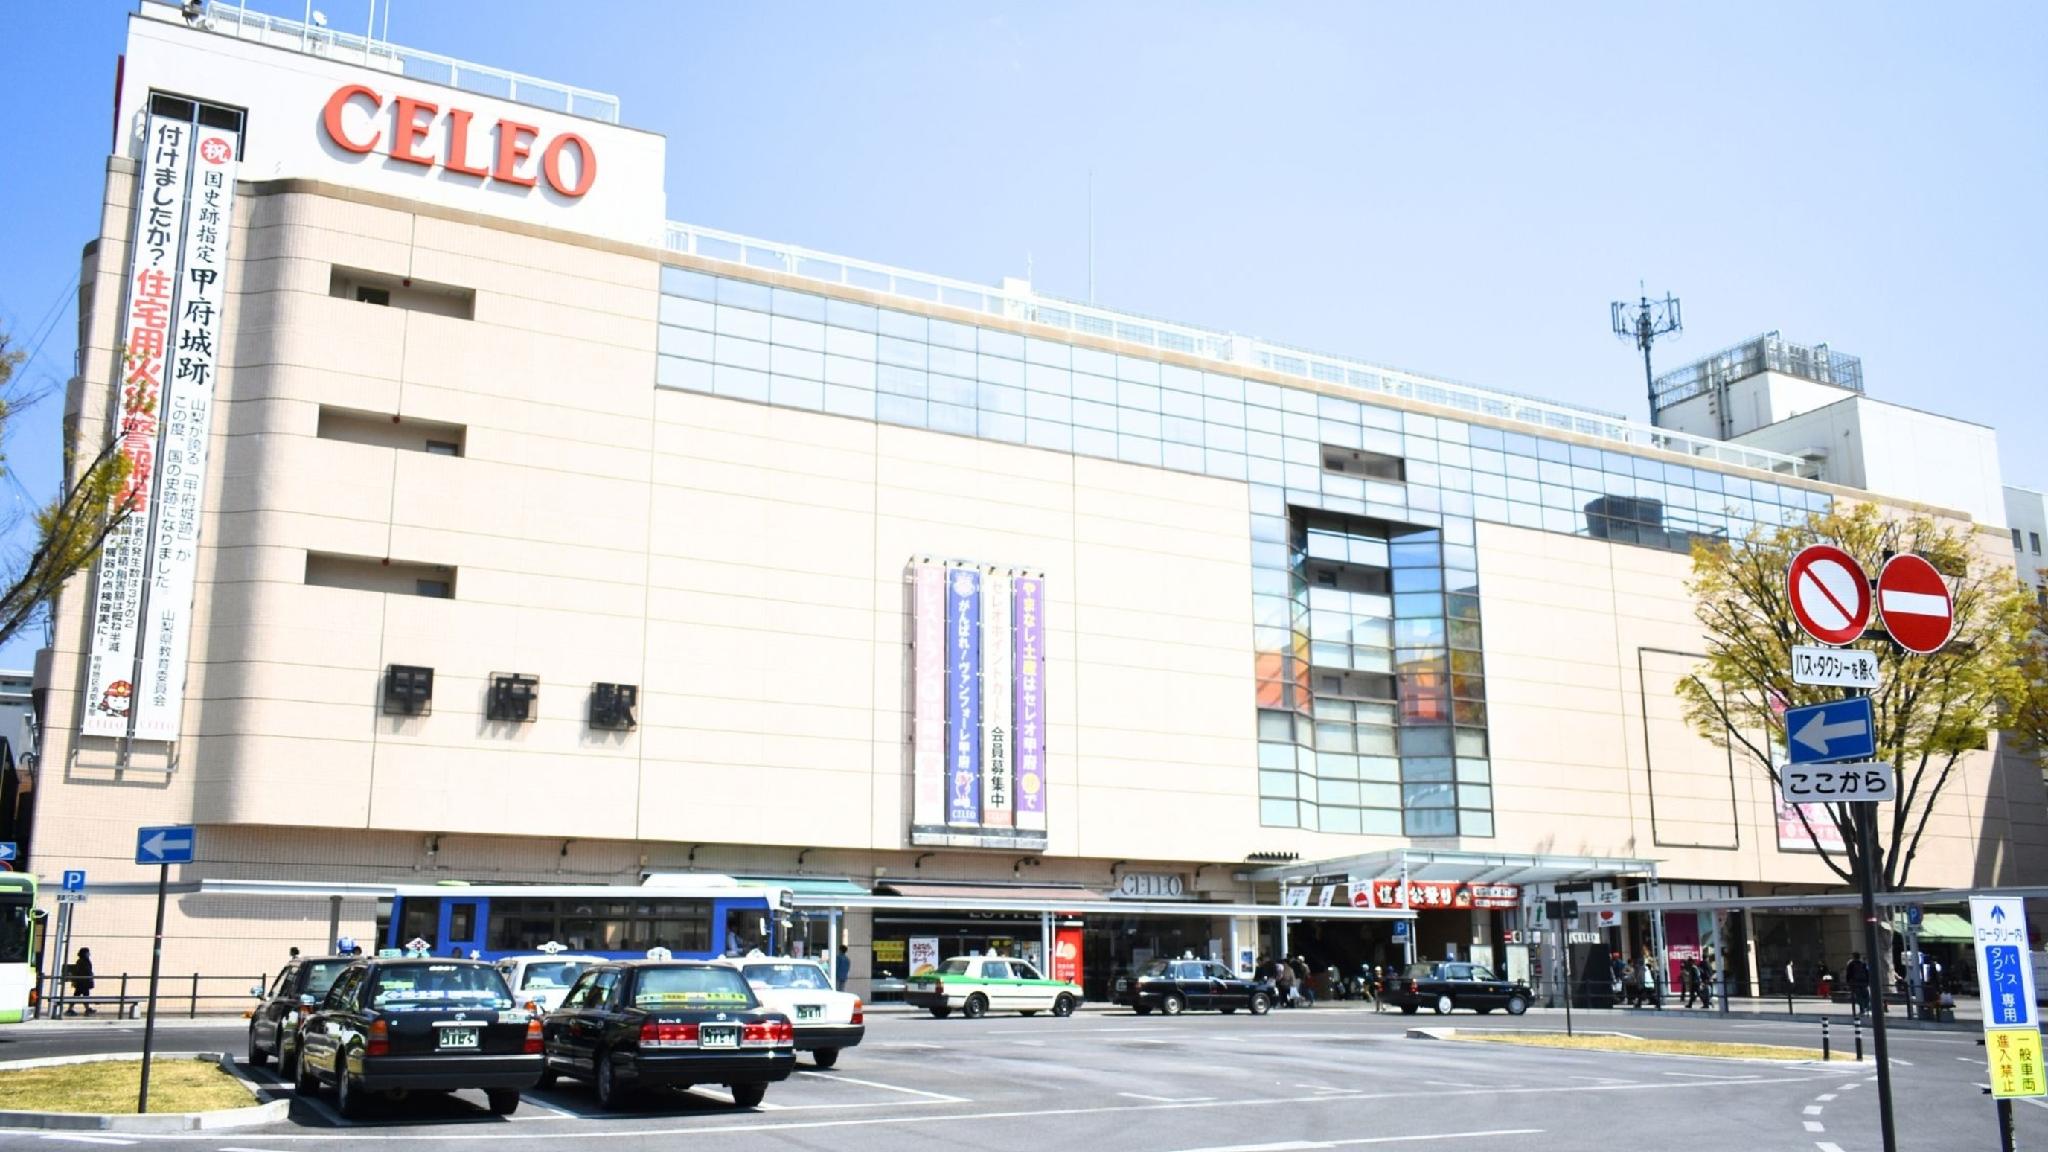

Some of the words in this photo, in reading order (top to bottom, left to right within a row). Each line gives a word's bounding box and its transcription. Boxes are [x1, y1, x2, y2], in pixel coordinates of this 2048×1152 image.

[201, 137, 232, 164] 祝
[323, 84, 597, 197] CELEO
[1795, 653, 1876, 681] バス・タクシーを除く
[991, 726, 1005, 808] 会員募集中
[1790, 770, 1887, 794] ここから
[67, 872, 81, 889] P
[1122, 874, 1183, 896] CELEO
[1978, 927, 2024, 942] ロータリー内
[1991, 947, 2005, 993] タクシー
[2004, 953, 2018, 985] バス
[2001, 992, 2018, 1023] 専用
[1996, 1034, 2016, 1093] 進入禁止
[2017, 1036, 2036, 1092] 一般車両
